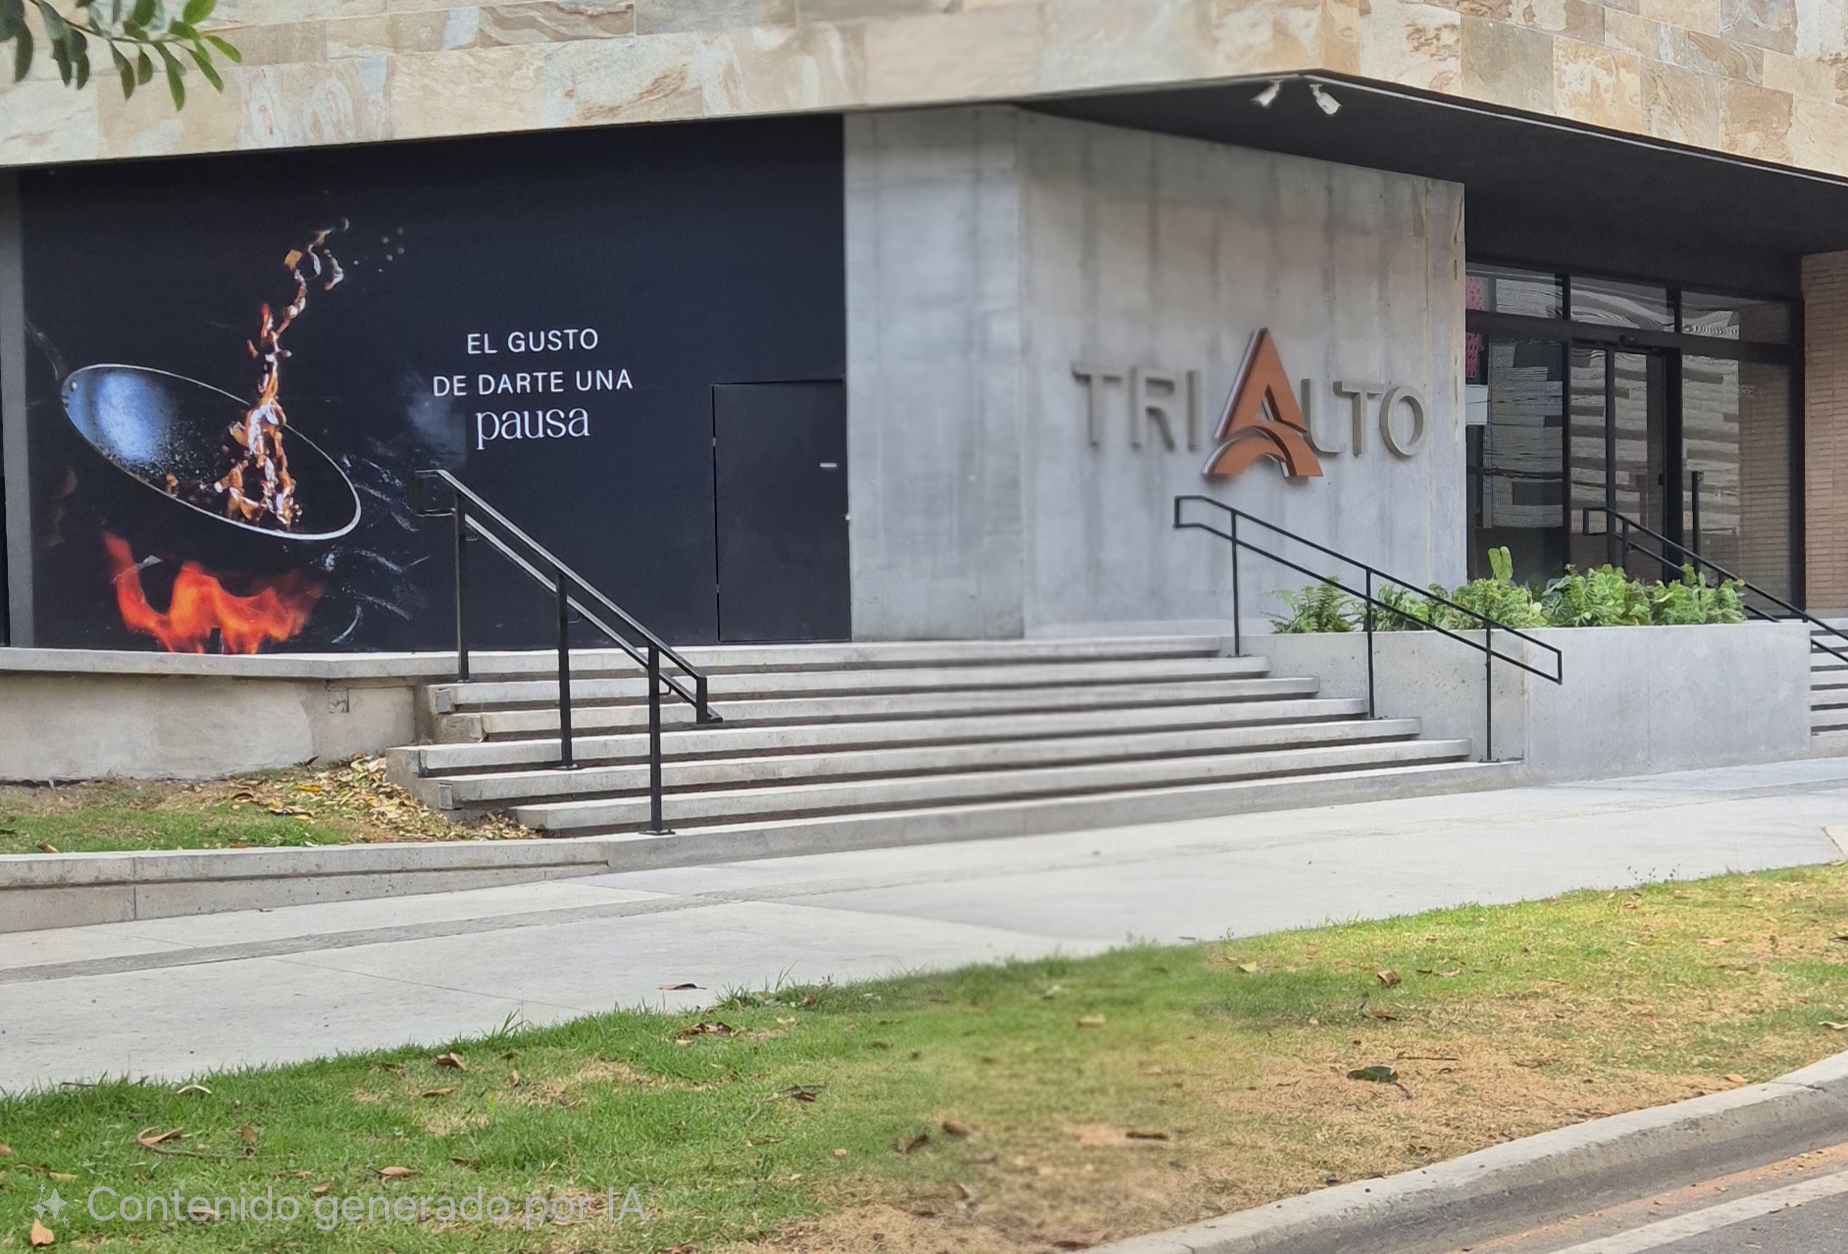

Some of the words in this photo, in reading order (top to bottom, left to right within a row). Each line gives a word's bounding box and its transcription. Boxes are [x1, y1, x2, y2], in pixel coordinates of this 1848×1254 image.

[467, 332, 498, 355] EL
[507, 327, 599, 353] GUSTO
[433, 375, 467, 397] DE
[478, 370, 564, 395] DARTE
[576, 368, 633, 392] UNA
[1070, 327, 1427, 478] TRIALTO
[475, 407, 591, 450] pausa
